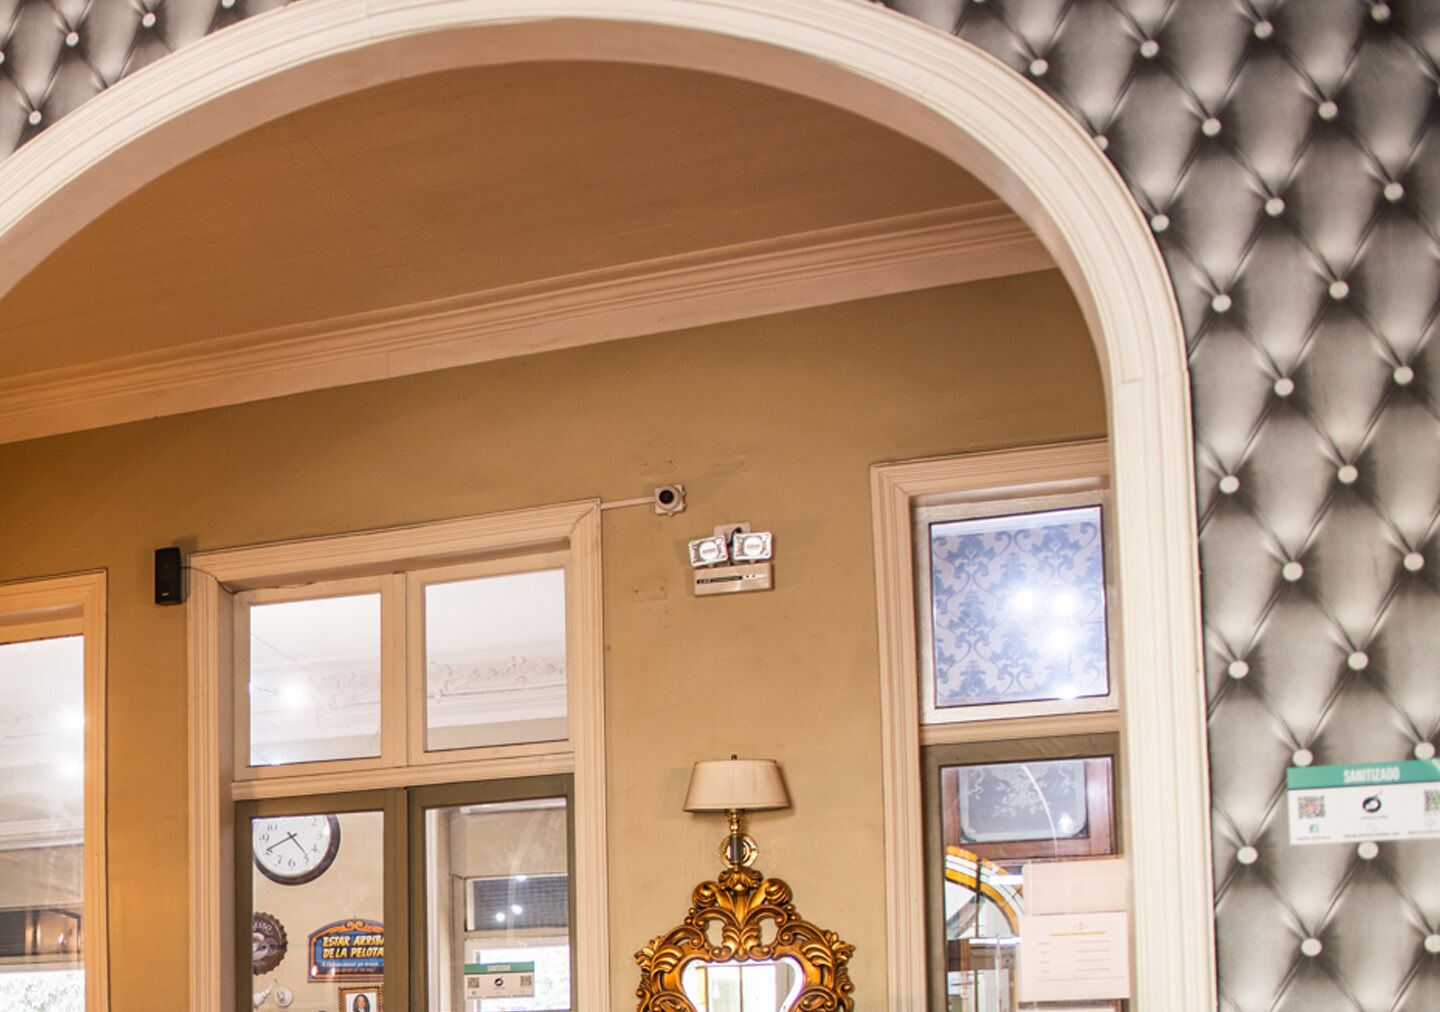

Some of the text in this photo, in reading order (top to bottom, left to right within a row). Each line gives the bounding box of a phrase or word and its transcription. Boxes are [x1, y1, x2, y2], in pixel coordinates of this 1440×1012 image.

[1343, 767, 1401, 784] SANITIZADO
[322, 935, 350, 948] ESTAR
[322, 947, 335, 959] DE
[335, 947, 347, 958] LA
